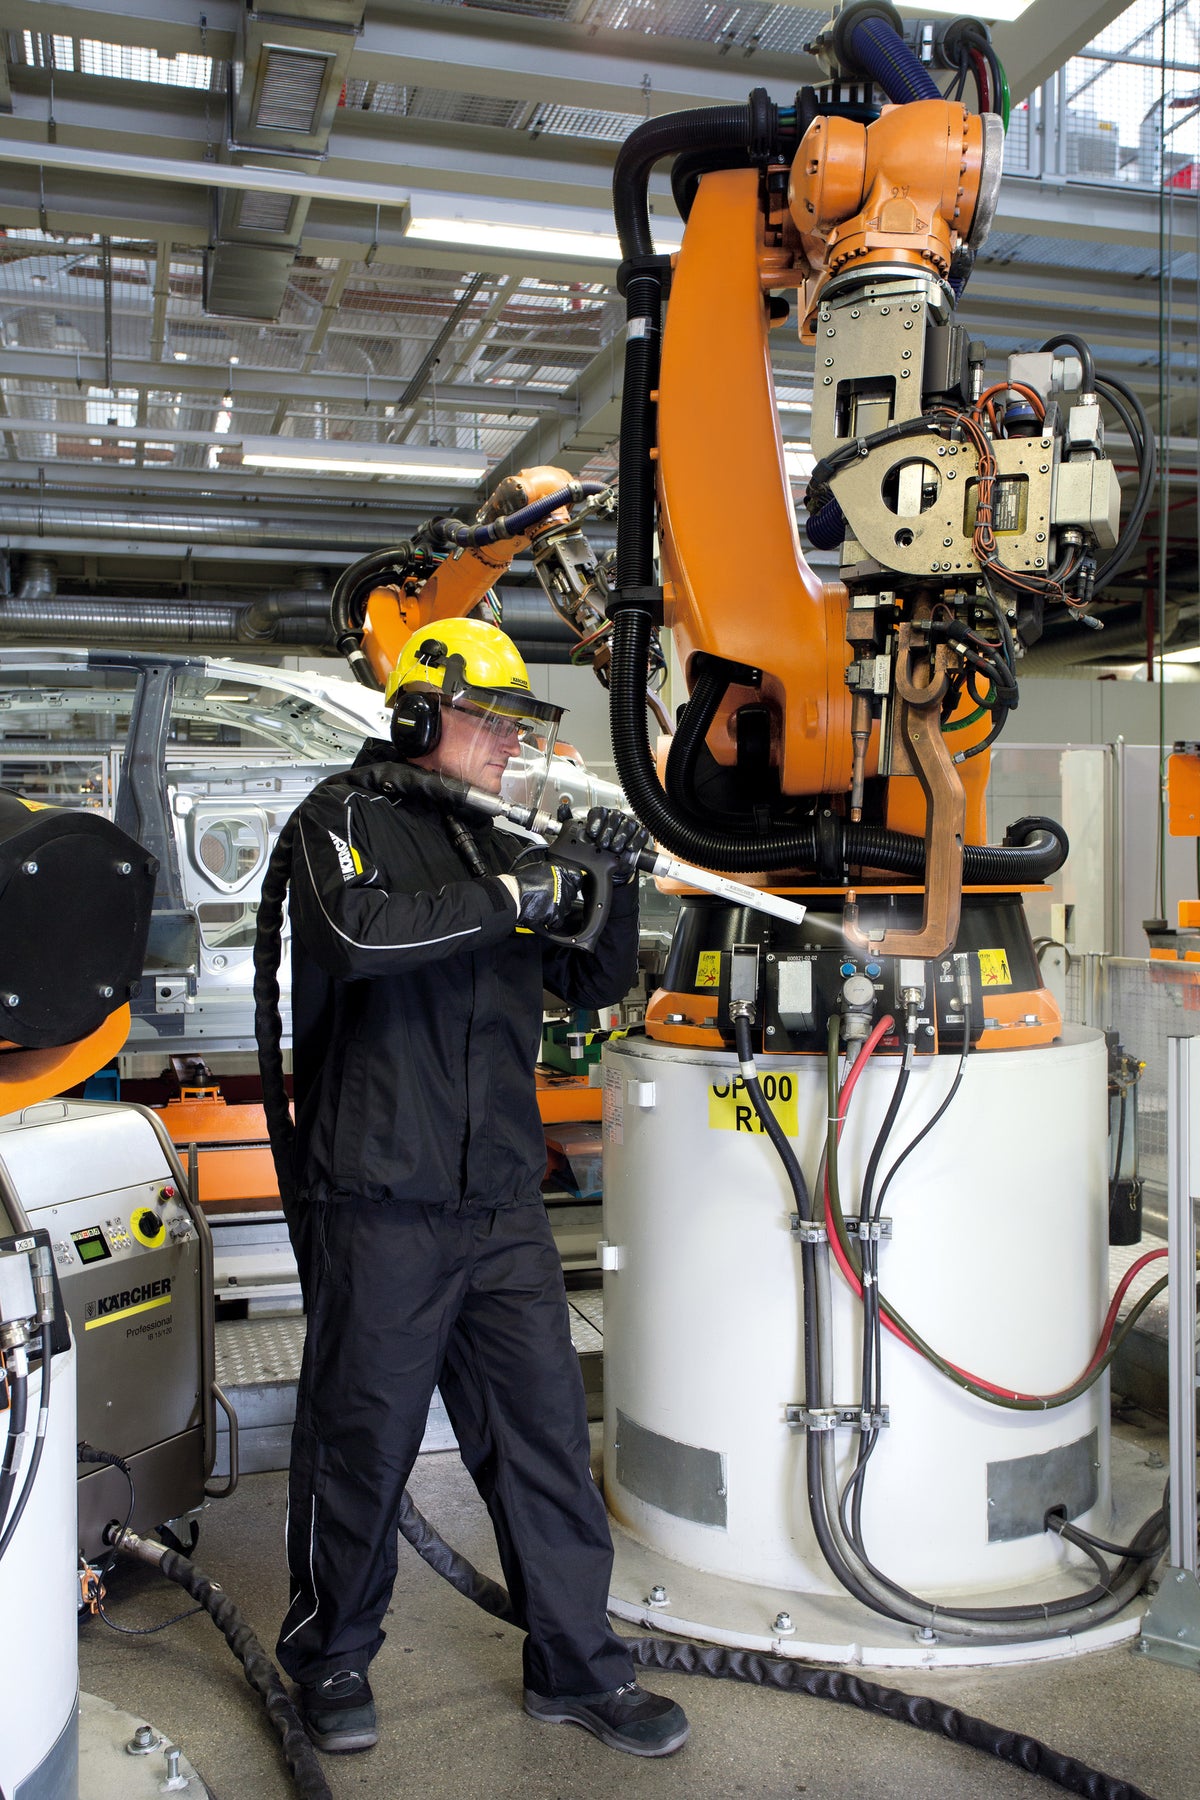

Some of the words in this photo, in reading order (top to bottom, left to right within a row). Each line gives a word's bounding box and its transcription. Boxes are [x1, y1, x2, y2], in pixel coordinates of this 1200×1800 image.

[712, 1073, 792, 1102] OP00
[98, 1278, 171, 1315] KÄRCHER
[126, 1315, 172, 1338] Professional
